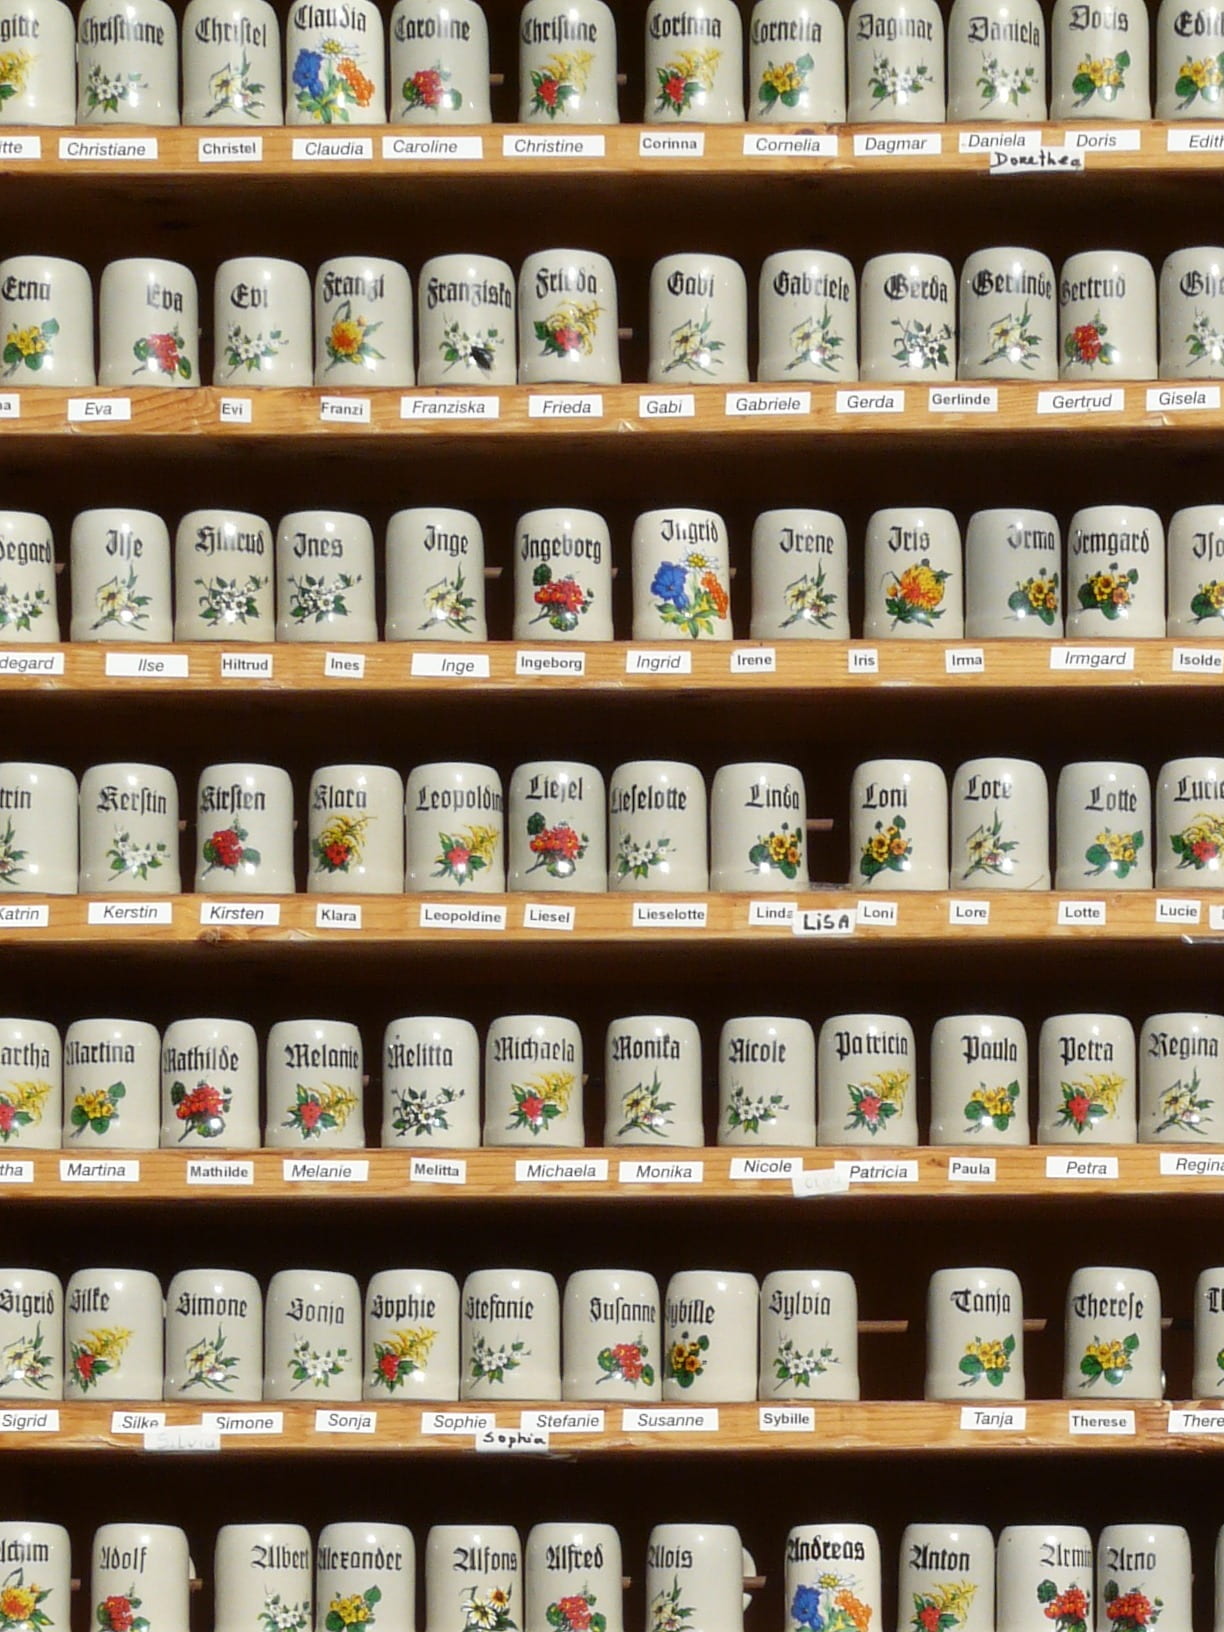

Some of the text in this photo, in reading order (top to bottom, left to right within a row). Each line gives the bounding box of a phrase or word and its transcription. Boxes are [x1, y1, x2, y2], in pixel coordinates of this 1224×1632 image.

[67, 142, 146, 156] Christiane
[393, 139, 458, 153] Caroline
[756, 138, 820, 152] Cornelia
[412, 400, 485, 414] Franziska
[736, 397, 801, 412] Gabriele
[1052, 394, 1113, 409] Gertrud
[84, 402, 112, 416] Eva
[138, 659, 164, 672] Ilse
[330, 658, 360, 671] Ines
[521, 656, 583, 672] Ingeborg
[636, 655, 681, 672] Ingrid
[1065, 651, 1127, 668] Irmgard
[103, 905, 158, 919] Kerstin
[210, 906, 264, 920] Kirsten
[425, 909, 501, 924] Leopoldine
[638, 908, 705, 920] Lieselotte
[1160, 904, 1198, 917] Lucie
[67, 1163, 126, 1177] Martina
[291, 1164, 352, 1178] Melanie
[527, 1164, 596, 1178] Michaela
[1066, 1161, 1107, 1175] Petra
[328, 1413, 371, 1430] Sonja
[763, 1412, 810, 1427] Sybille
[1072, 1415, 1127, 1427] Therese
[483, 1431, 547, 1446] Sophia
